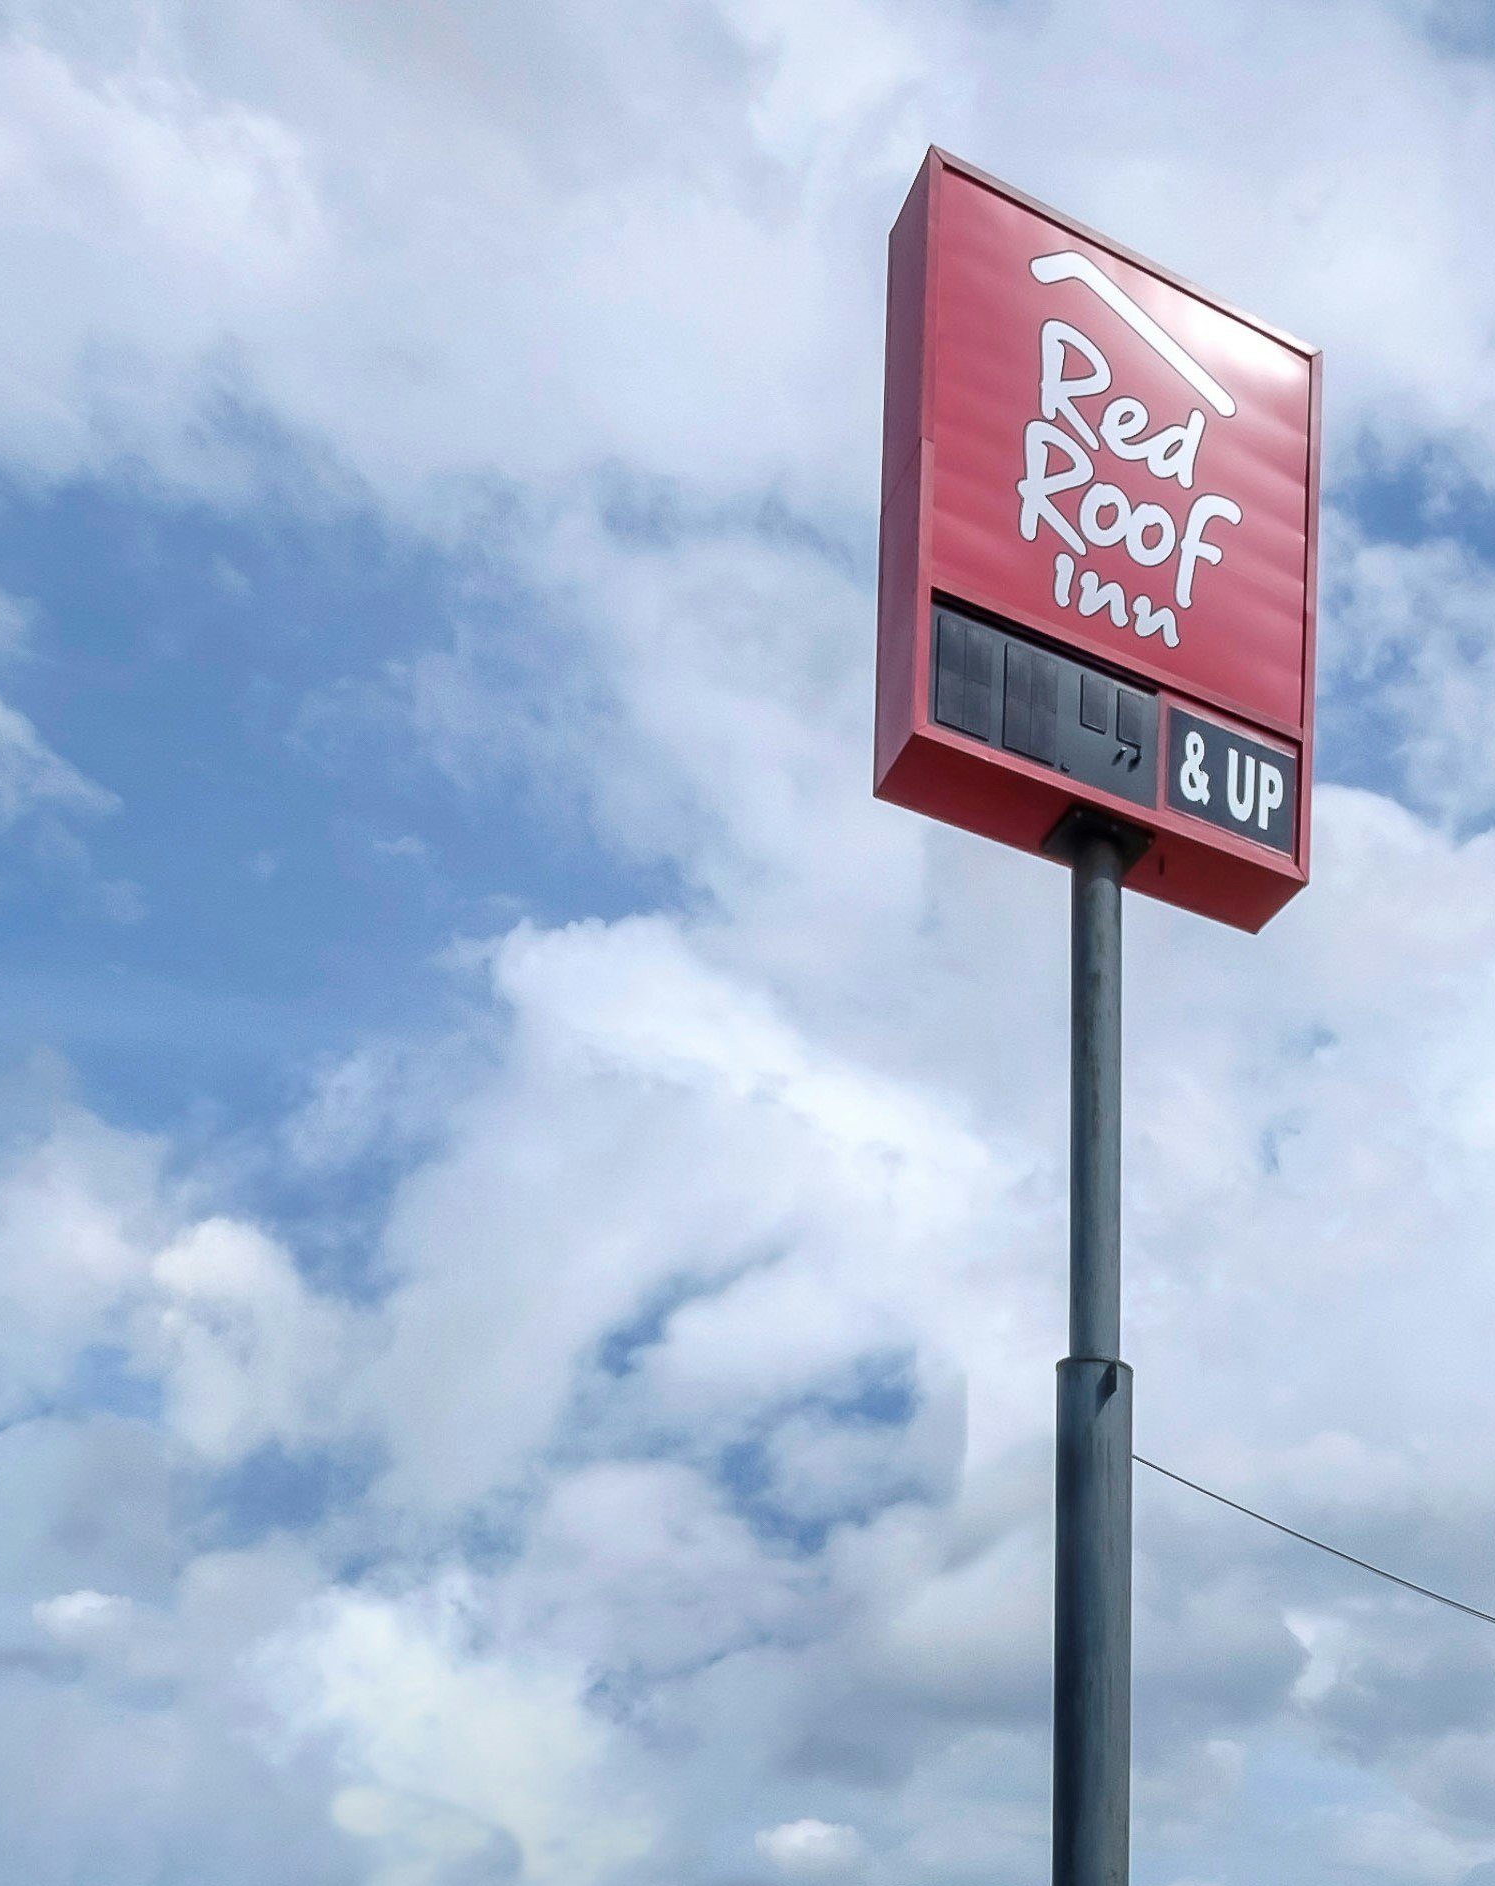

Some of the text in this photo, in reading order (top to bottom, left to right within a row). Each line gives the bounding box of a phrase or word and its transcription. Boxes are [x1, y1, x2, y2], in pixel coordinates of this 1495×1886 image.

[1040, 319, 1206, 488] Red
[1017, 418, 1243, 608] Roof
[1179, 731, 1284, 832] & UP
